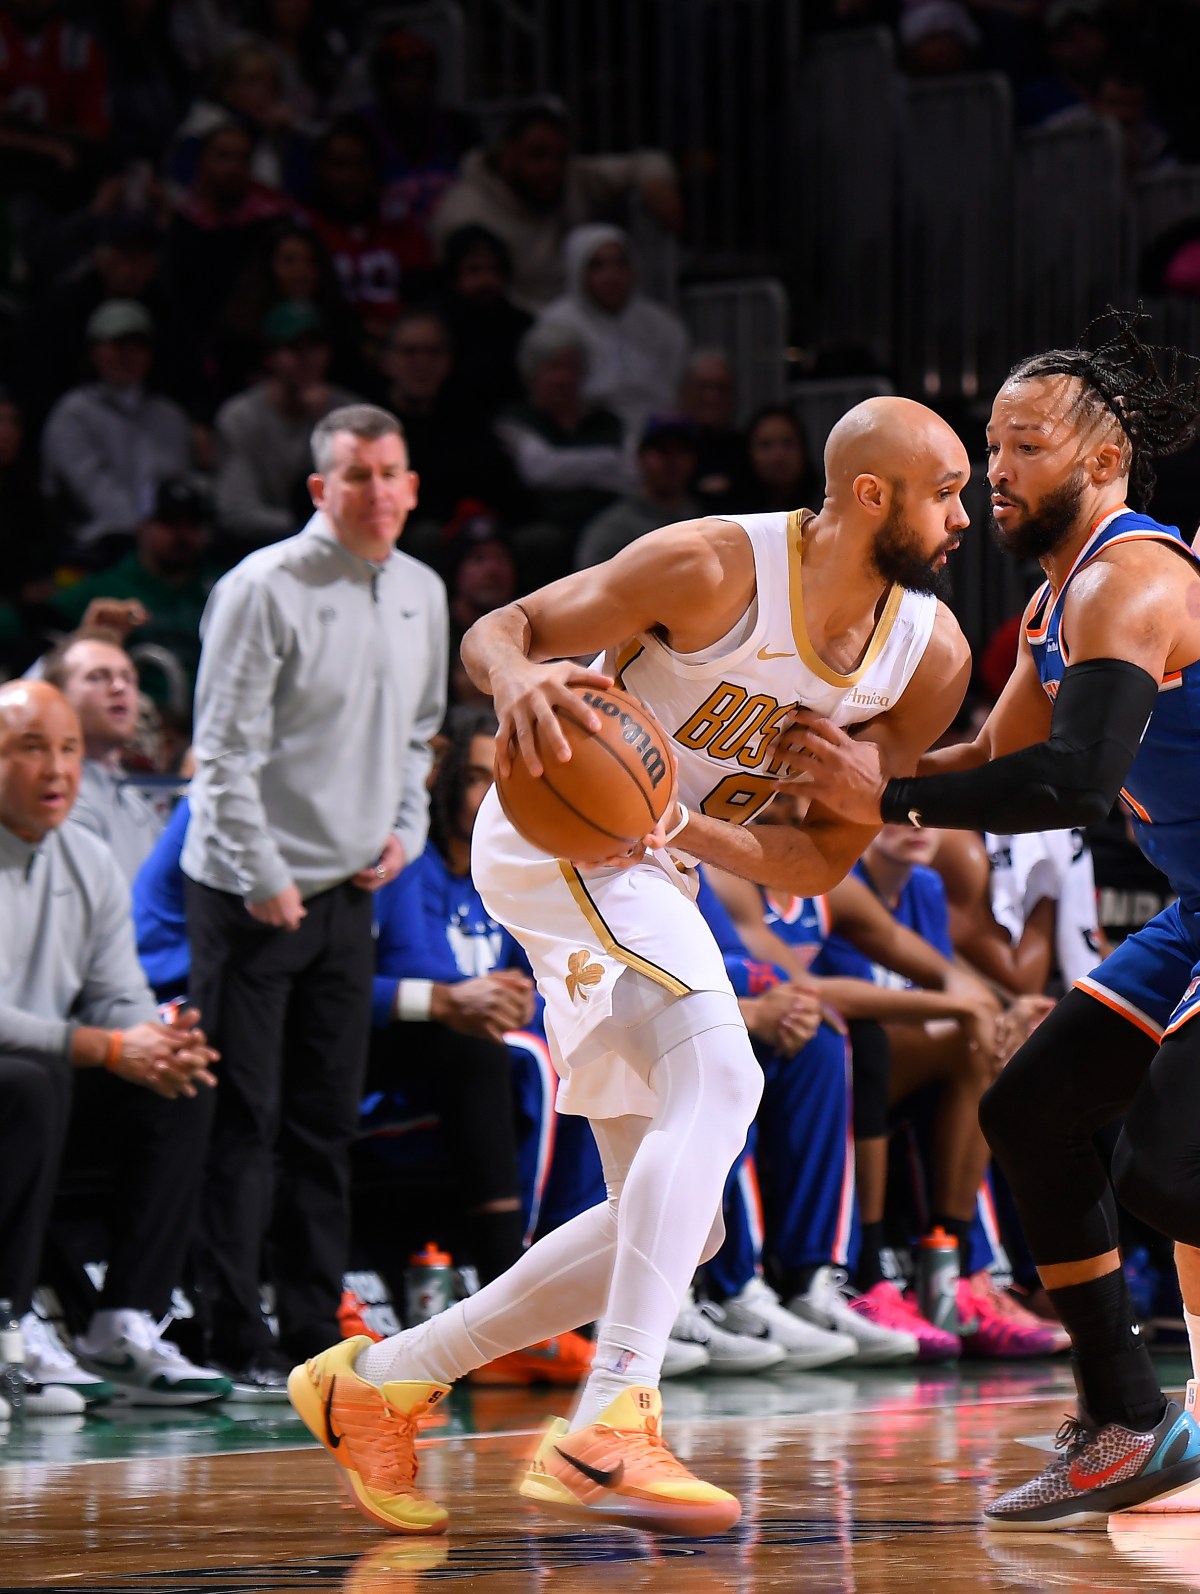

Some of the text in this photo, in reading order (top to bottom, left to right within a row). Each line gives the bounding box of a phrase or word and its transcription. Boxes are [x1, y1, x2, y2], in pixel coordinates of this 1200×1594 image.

[582, 692, 666, 790] Wilson
[672, 680, 804, 776] BOS
[844, 687, 890, 707] Amica
